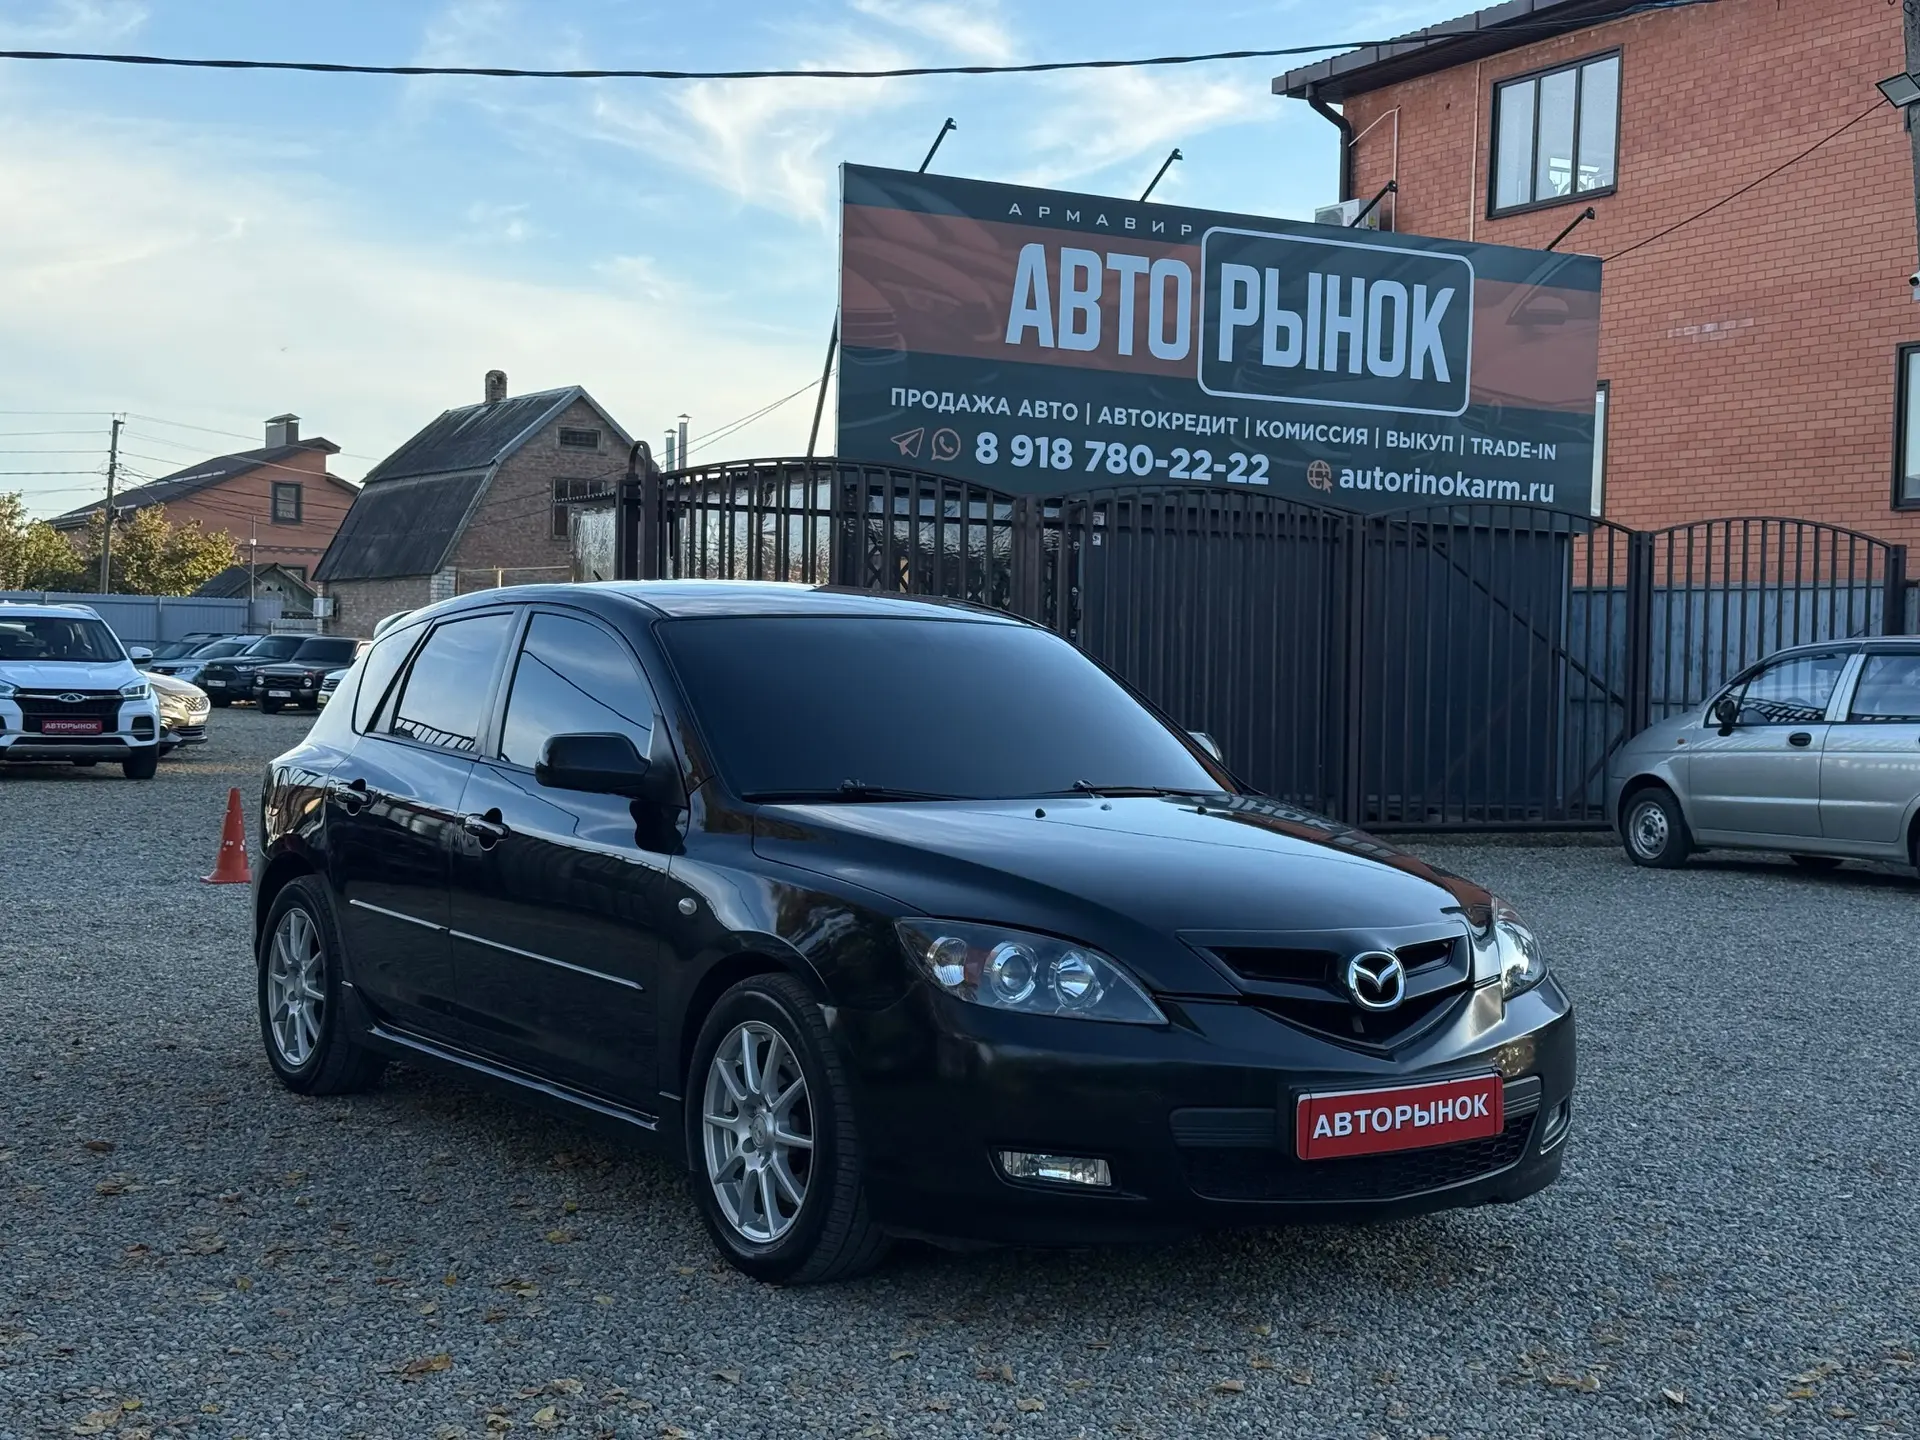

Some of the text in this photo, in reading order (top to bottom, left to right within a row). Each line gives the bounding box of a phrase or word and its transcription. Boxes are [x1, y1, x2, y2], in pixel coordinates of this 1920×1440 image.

[1008, 203, 1193, 236] АРМАВИР
[1005, 243, 1456, 383] АВТО РЫНОК
[891, 387, 1557, 460] ПРОДАЖА АВТО АВТОКРЕДИТ КОМИССИЯ ВЫКУП TRADE-IN
[975, 431, 1270, 485] 8 918 780-22-22
[1339, 466, 1555, 503] autorinokarm.ru
[44, 722, 98, 730] АВТОРЫНОК
[1312, 1092, 1490, 1139] АВТОРЫНОК
